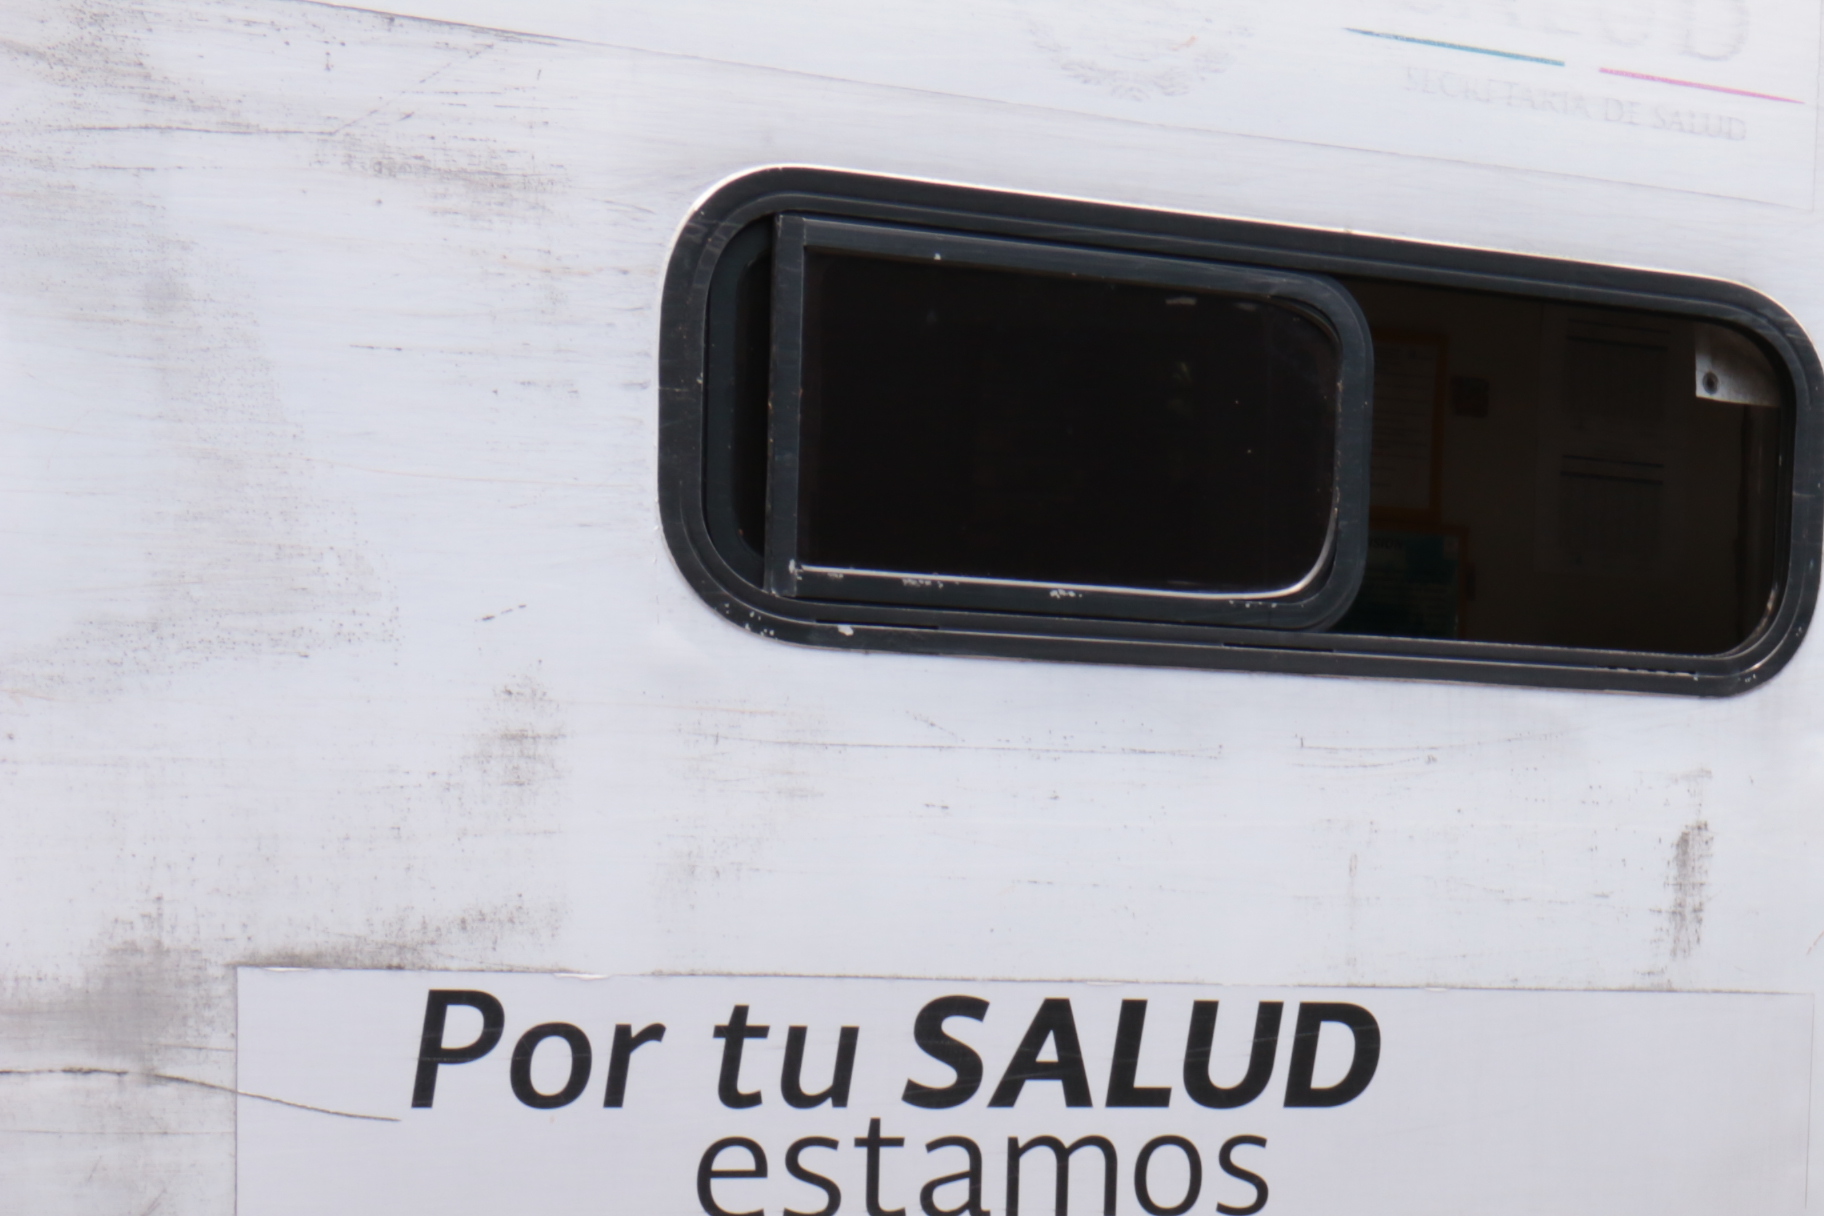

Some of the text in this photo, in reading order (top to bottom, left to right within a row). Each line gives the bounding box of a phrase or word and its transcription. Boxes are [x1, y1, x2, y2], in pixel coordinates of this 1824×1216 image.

[1604, 97, 1643, 126] DE
[1648, 104, 1747, 142] SALUD
[411, 989, 1381, 1110] Por tu SALUD
